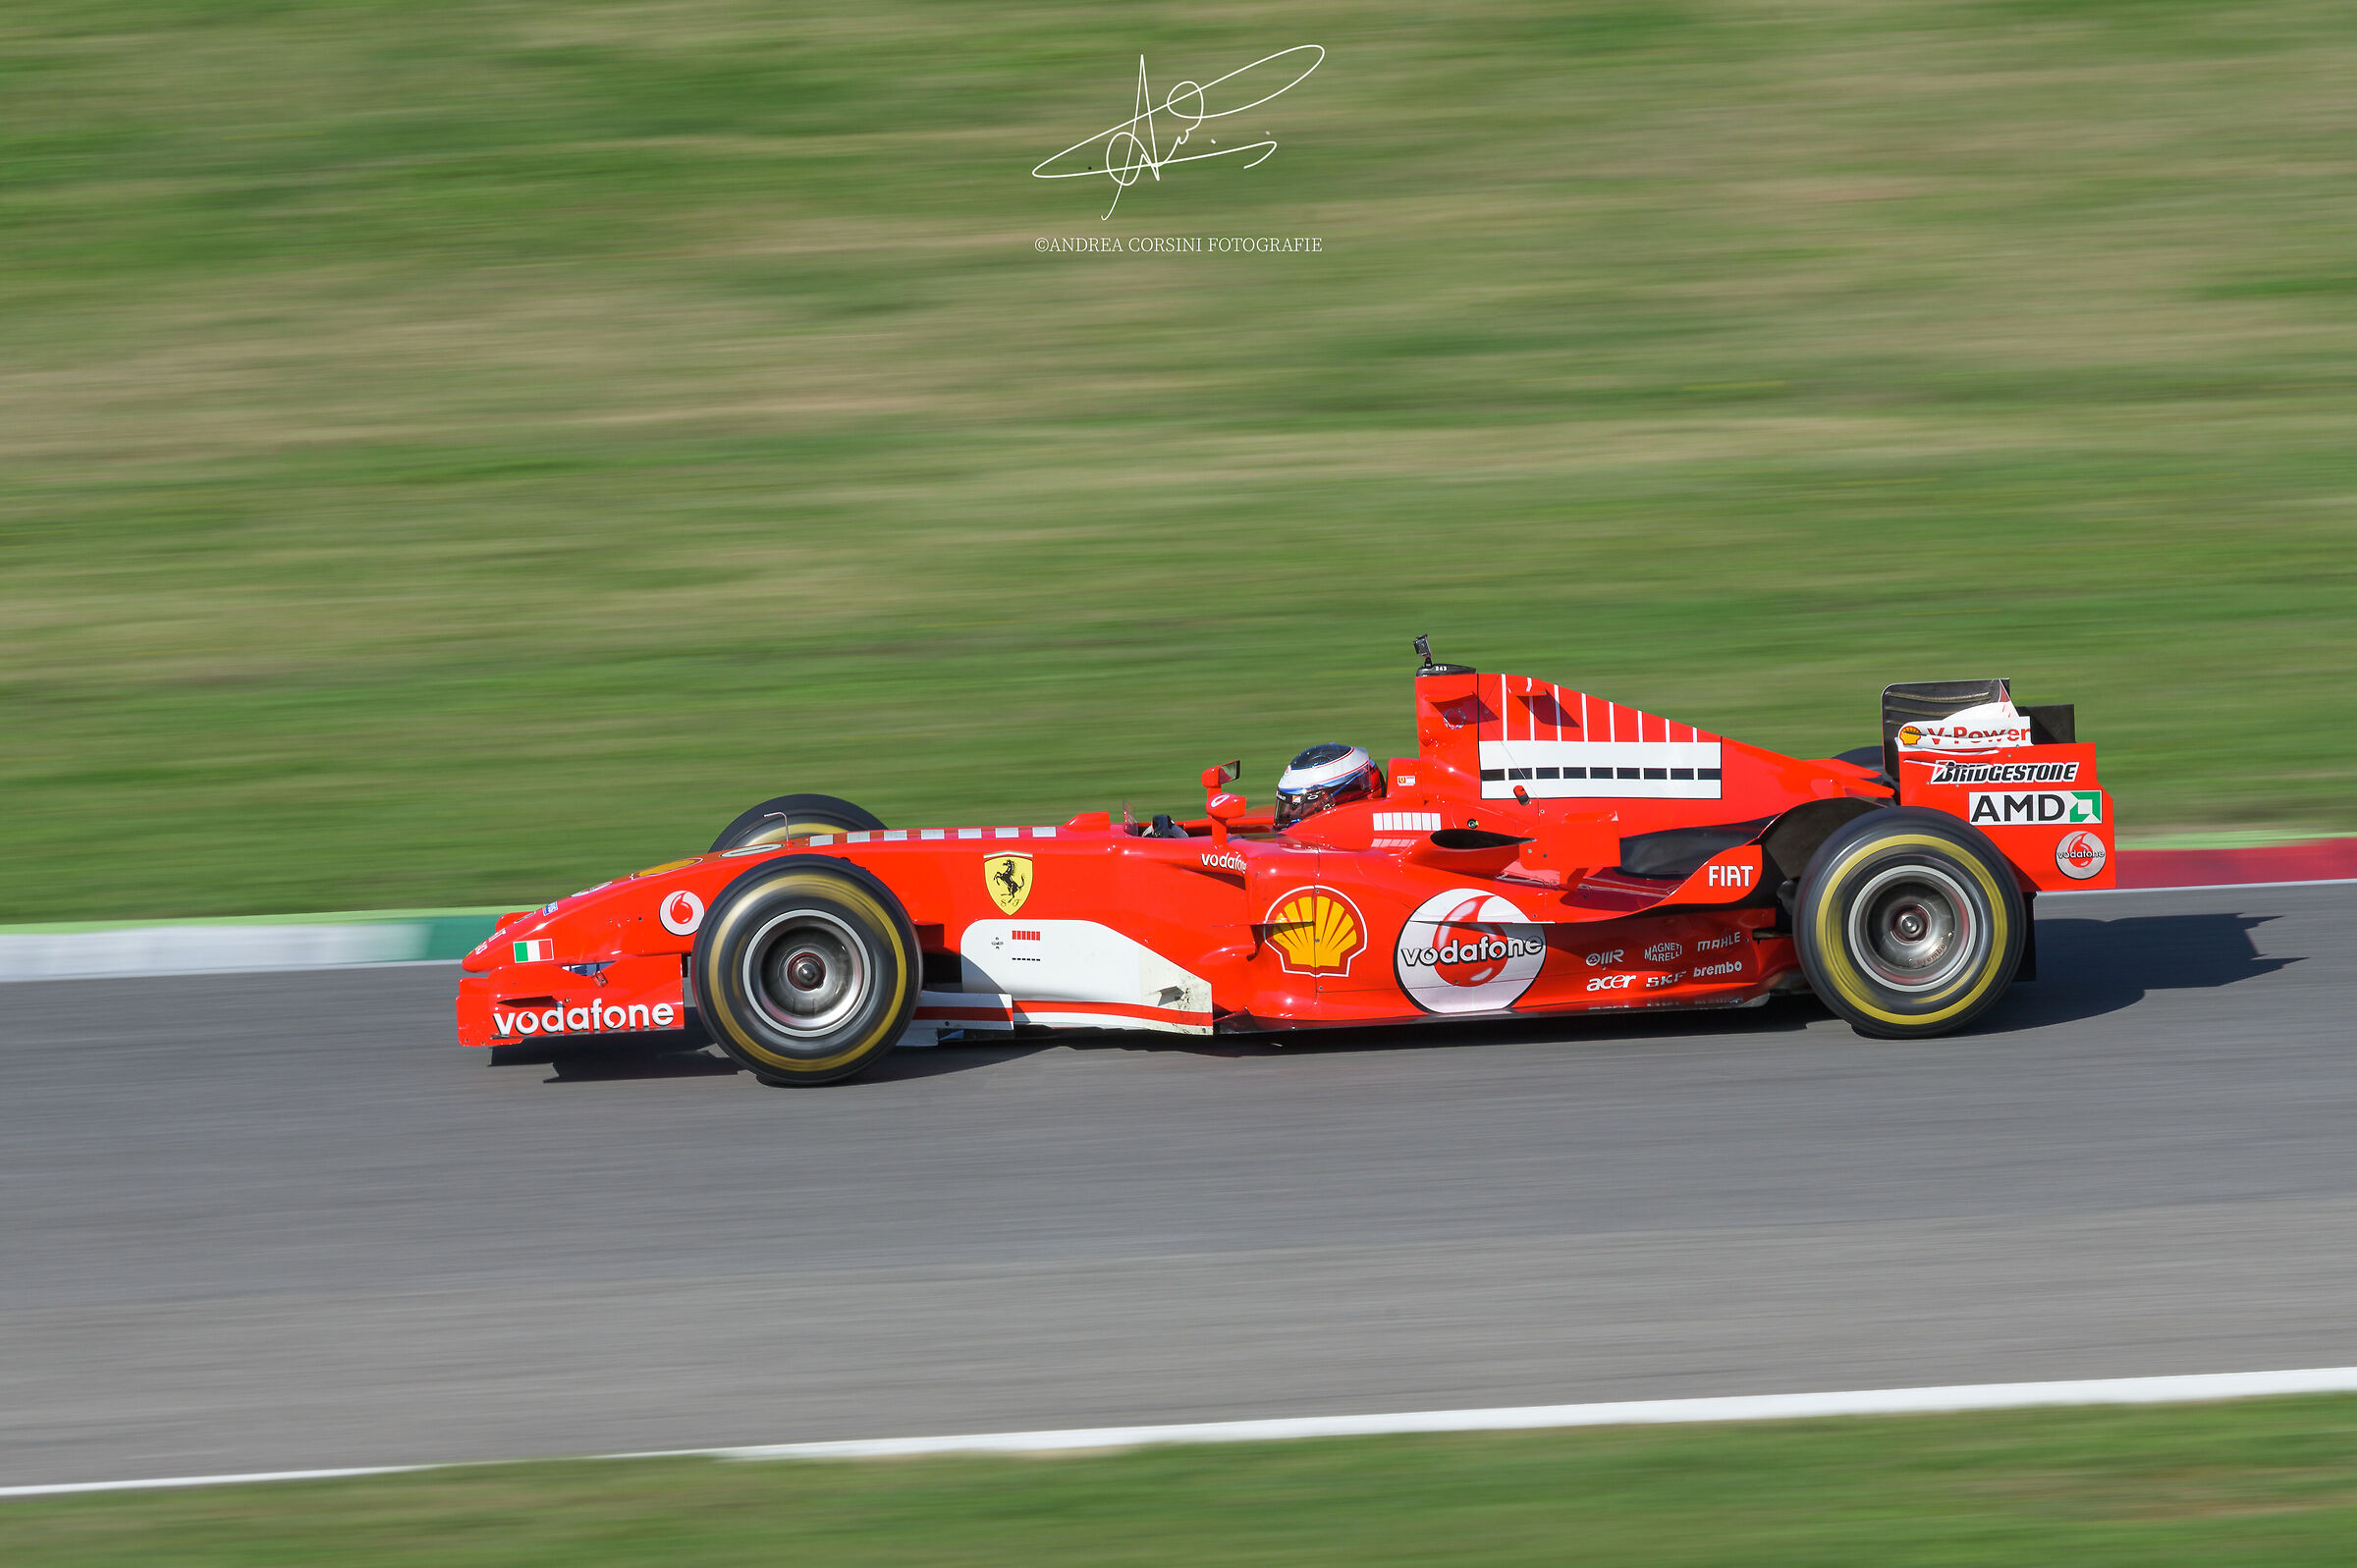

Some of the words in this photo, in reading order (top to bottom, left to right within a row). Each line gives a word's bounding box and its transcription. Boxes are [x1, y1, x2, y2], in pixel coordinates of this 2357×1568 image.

[1927, 726, 2031, 744] V-Power
[1932, 761, 2077, 783] BRIDGESTONE
[1970, 793, 2065, 823] AMD
[2057, 849, 2106, 859] vodafone
[1709, 865, 1754, 887] FIAT
[1401, 936, 1545, 966] vodafone
[1697, 932, 1741, 952] MAHLE
[1645, 970, 1687, 988] SKF
[1693, 960, 1743, 978] brembo
[1586, 974, 1637, 992] acer
[493, 999, 674, 1035] vodafone
